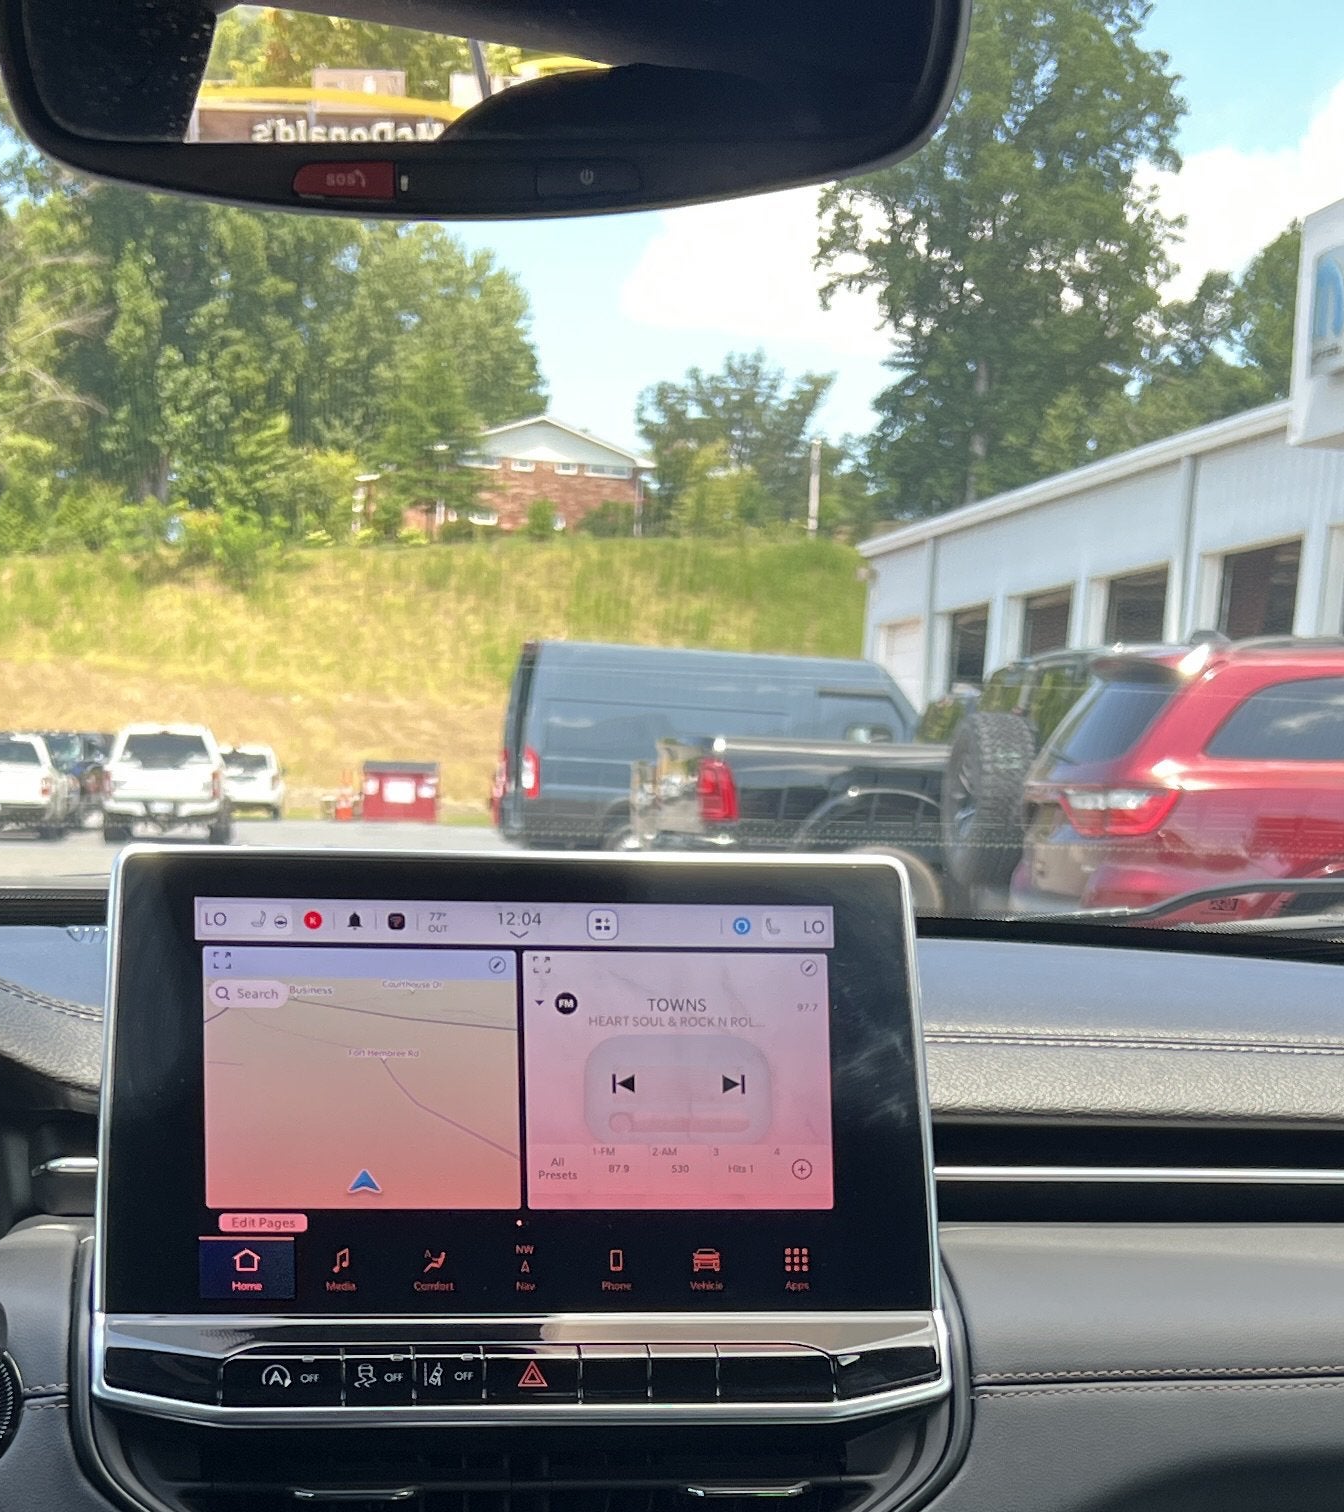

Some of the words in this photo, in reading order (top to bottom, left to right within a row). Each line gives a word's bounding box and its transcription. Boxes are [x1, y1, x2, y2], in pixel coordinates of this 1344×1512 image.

[326, 172, 358, 187] SOS
[204, 911, 228, 926] LO
[497, 911, 542, 927] 12:04
[428, 924, 448, 933] OUT
[803, 919, 825, 935] LO
[236, 986, 280, 1001] Search
[288, 985, 334, 996] Business
[646, 997, 707, 1013] TOWNS
[796, 1002, 818, 1013] 97.7
[588, 1015, 630, 1027] HEART
[631, 1016, 666, 1027] SOUL
[667, 1016, 678, 1027] &
[679, 1016, 717, 1028] ROCK
[717, 1017, 729, 1028] N
[550, 1157, 565, 1168] All
[538, 1169, 578, 1180] Presets
[671, 1164, 690, 1174] 530
[231, 1217, 256, 1229] Edit
[258, 1217, 296, 1230] Pages
[231, 1281, 263, 1292] Home
[325, 1281, 358, 1292] Media
[413, 1281, 455, 1292] Comfort
[515, 1281, 536, 1292] Nav
[601, 1281, 632, 1291] Phone
[689, 1280, 724, 1291] Vehicle
[784, 1281, 810, 1292] Apps
[300, 1373, 321, 1384] OFF
[383, 1372, 405, 1383] OFF
[454, 1371, 475, 1382] OFF
